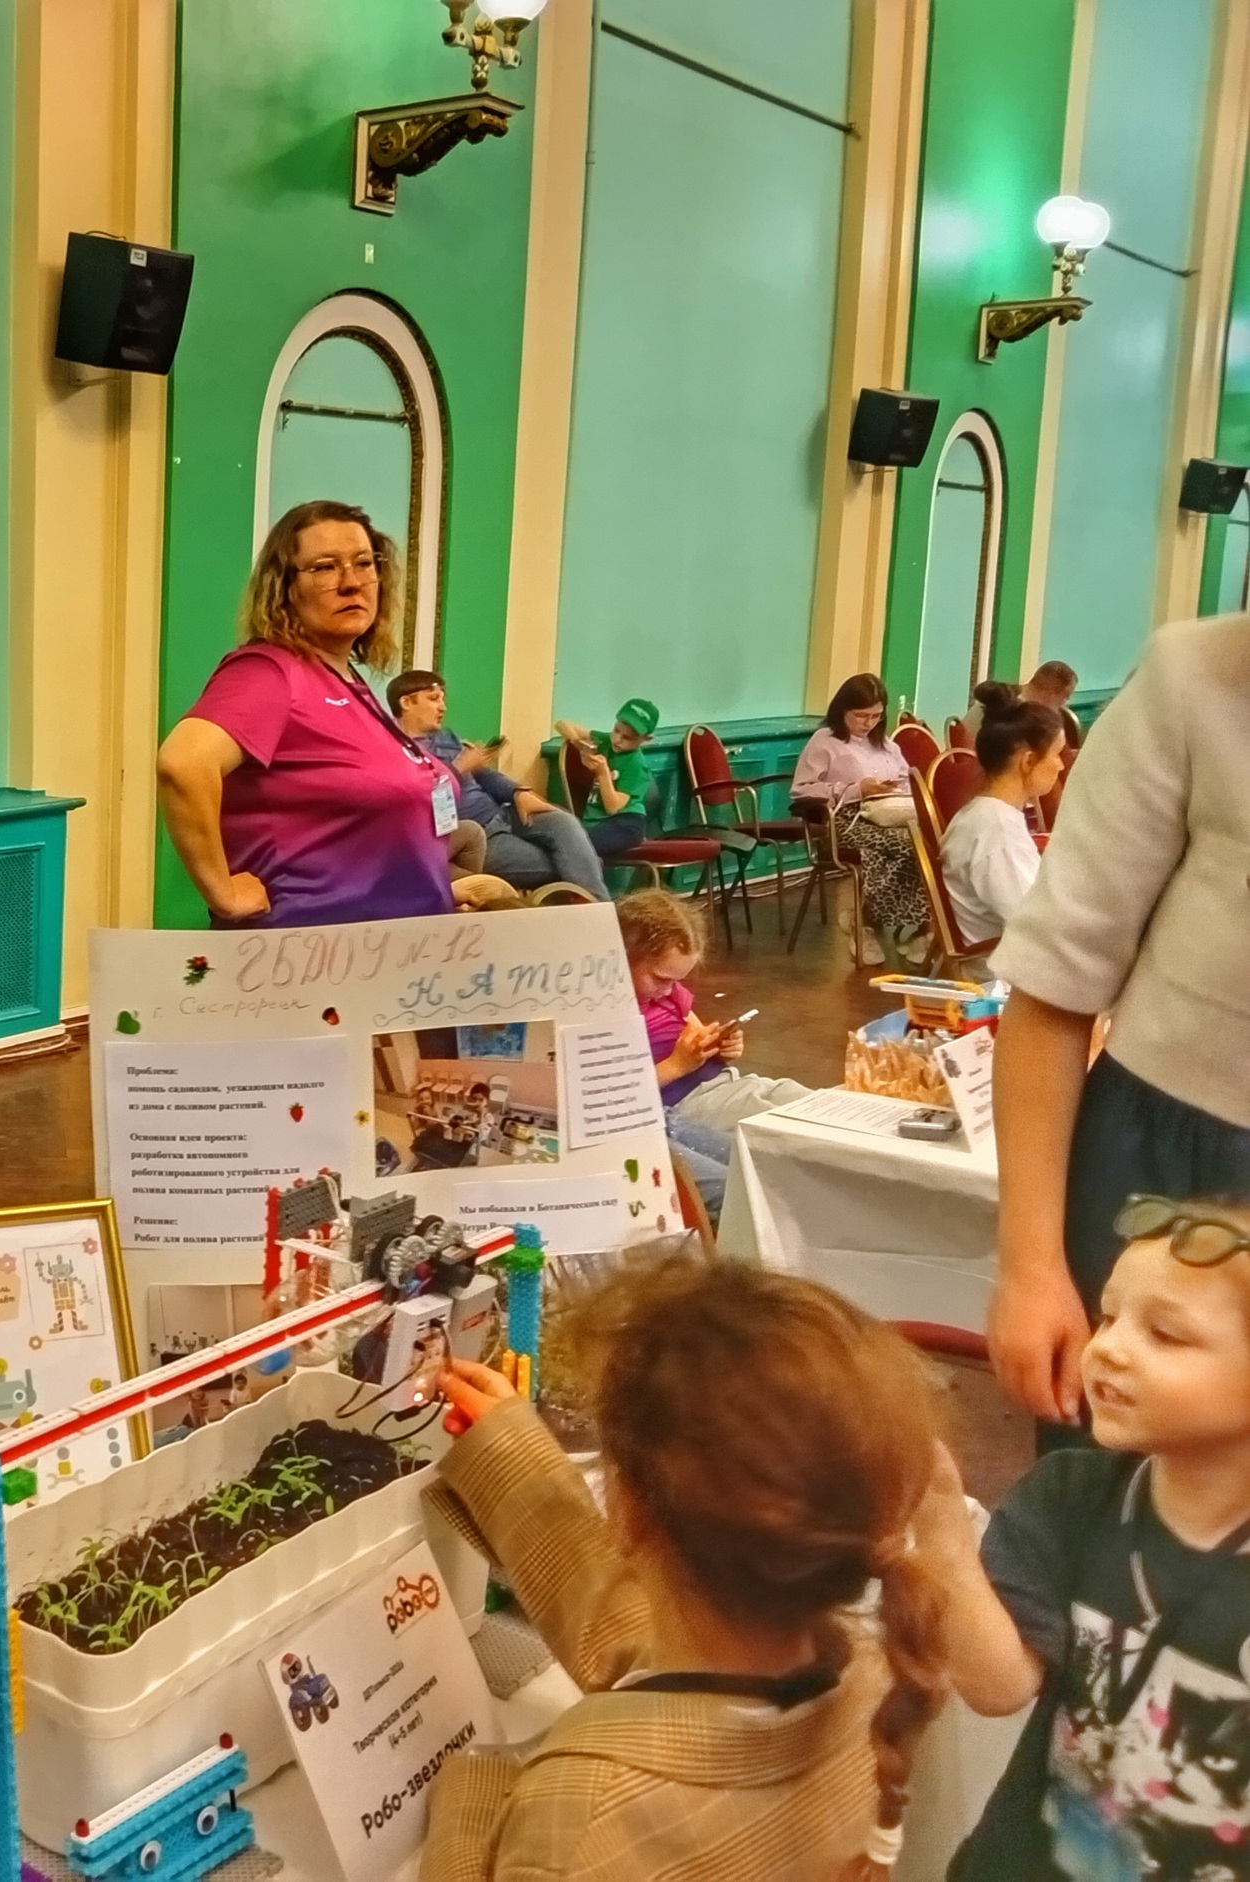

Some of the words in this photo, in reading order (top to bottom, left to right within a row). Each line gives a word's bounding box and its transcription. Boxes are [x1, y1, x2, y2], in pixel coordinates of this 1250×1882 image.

[127, 1066, 178, 1077] Проблема:
[128, 1085, 166, 1094] помощь
[168, 1084, 221, 1094] садоводам,
[226, 1082, 284, 1094] уезжающим
[287, 1080, 325, 1091] надолго
[129, 1103, 139, 1111] из
[141, 1103, 165, 1112] дома
[174, 1103, 216, 1111] поливом
[218, 1101, 267, 1112] растений.
[130, 1132, 176, 1142] Основная
[179, 1134, 201, 1143] идея
[204, 1133, 248, 1144] проекта:
[131, 1150, 184, 1161] разработка
[186, 1151, 249, 1160] автономного
[131, 1168, 225, 1178] роботизированного
[226, 1166, 281, 1179] устройства
[282, 1167, 301, 1176] для
[132, 1186, 166, 1195] полива
[168, 1187, 224, 1195] комнатных
[459, 1205, 477, 1215] Мы
[478, 1203, 526, 1213] побывали
[537, 1200, 600, 1212] Ботаническом
[133, 1216, 178, 1226] Решение:
[134, 1233, 161, 1243] Робот
[162, 1235, 180, 1243] для
[183, 1235, 218, 1244] полива
[352, 1708, 401, 1754] Творческая
[400, 1674, 438, 1713] категория
